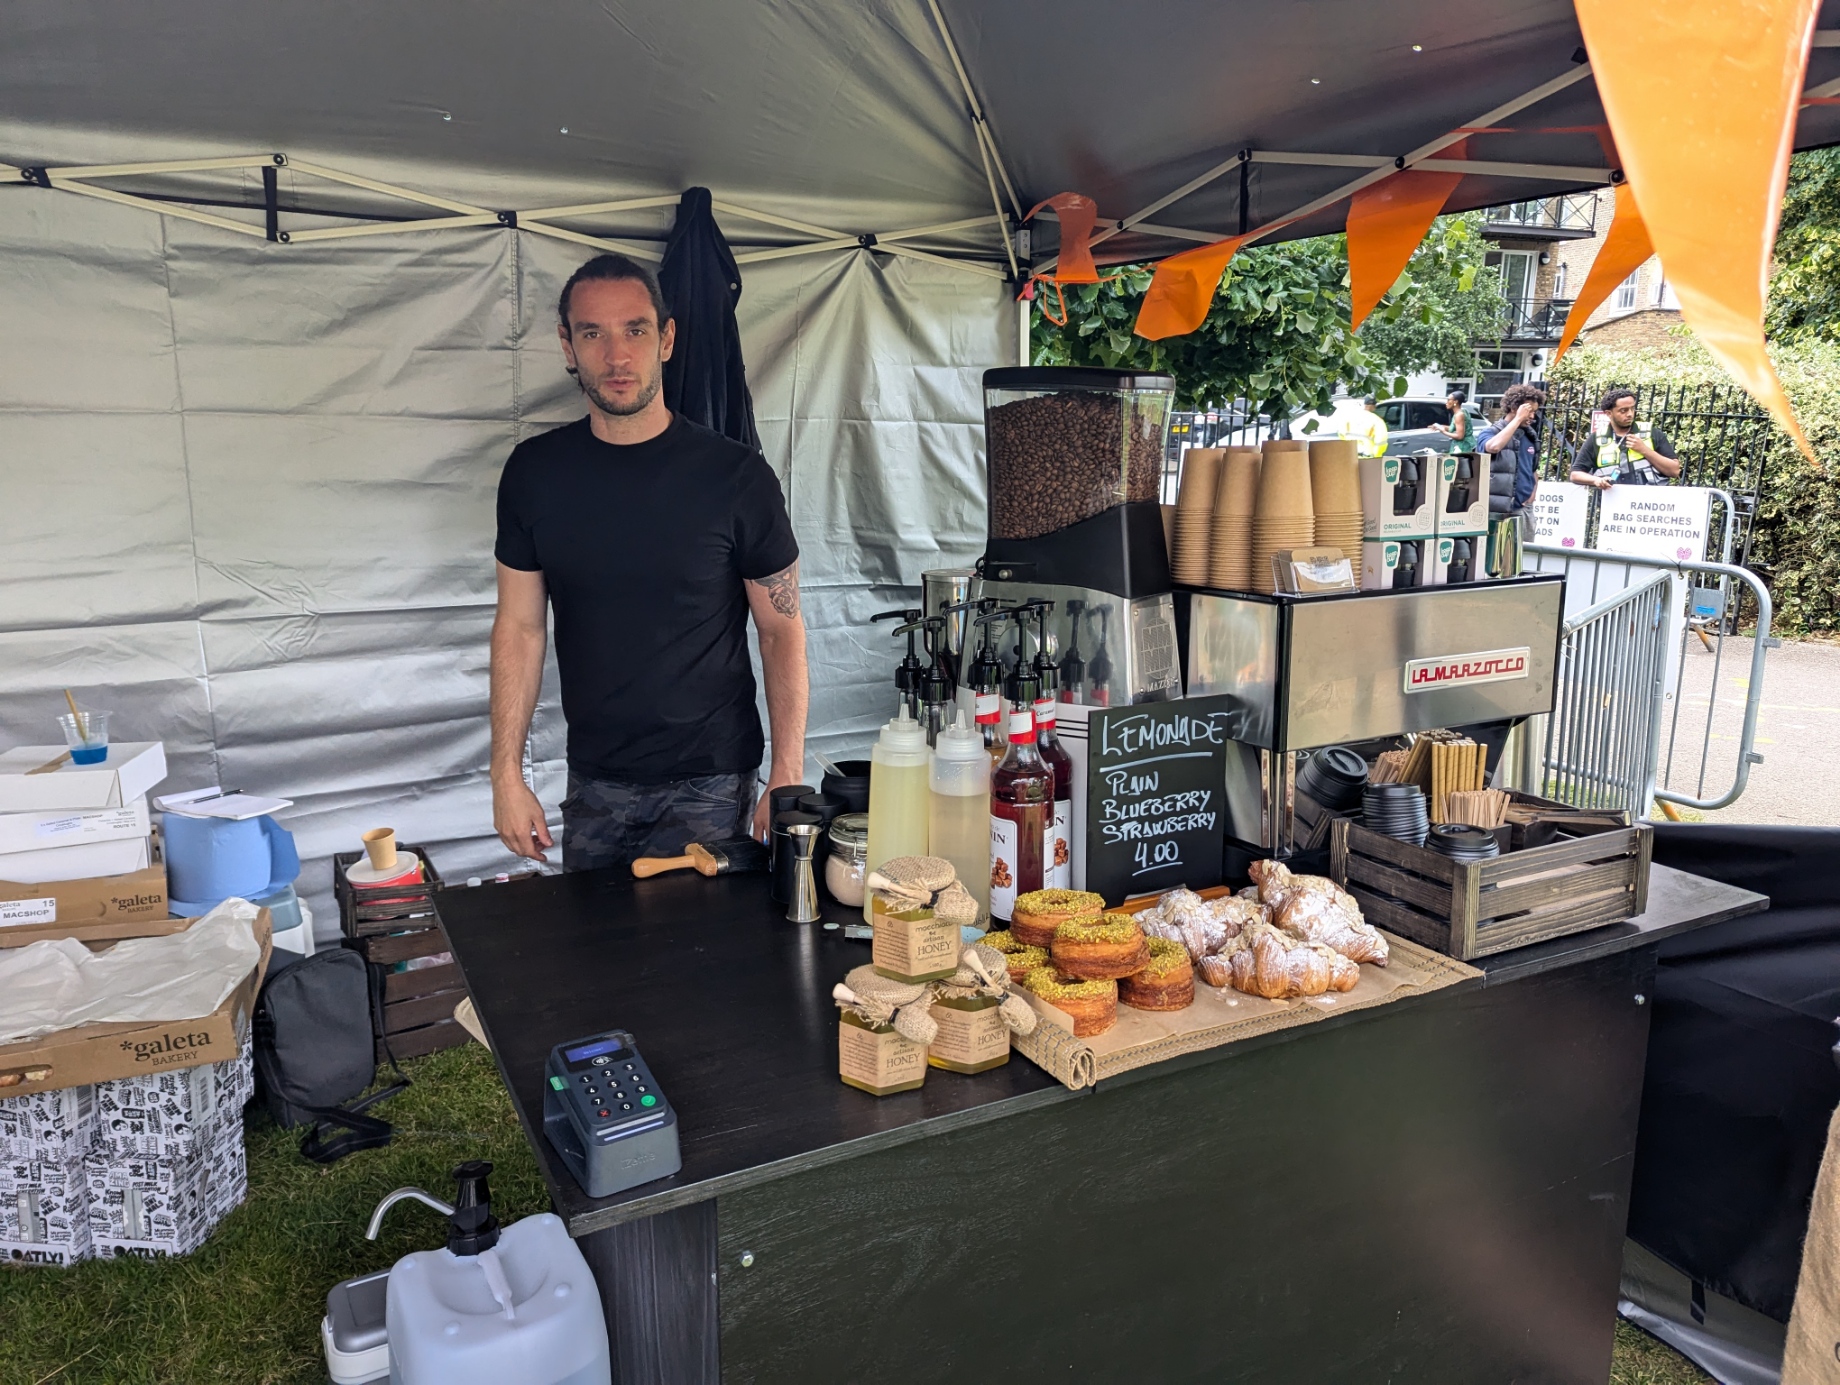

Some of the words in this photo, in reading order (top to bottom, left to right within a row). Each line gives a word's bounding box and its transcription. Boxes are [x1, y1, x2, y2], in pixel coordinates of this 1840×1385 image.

[1539, 494, 1564, 503] DOGS
[1534, 505, 1545, 513] ST
[1547, 506, 1560, 514] BE
[1630, 502, 1675, 512] RANDOM
[1383, 522, 1412, 530] ORIGINAL
[1546, 517, 1560, 526] ON
[1613, 512, 1633, 522] BAG
[1636, 514, 1692, 526] SEARCHES
[1535, 527, 1553, 537] ADS
[1603, 524, 1623, 533] ARE
[1626, 525, 1636, 534] IN
[1639, 526, 1700, 539] OPERATION
[1412, 668, 1429, 684] LA
[1434, 657, 1525, 682] MARZOCCO
[1102, 713, 1231, 756] LEMONADE
[1105, 770, 1159, 797] PLAIN
[1098, 790, 1211, 824] BLUEBERRY
[1102, 812, 1216, 845] STRAWBERRY
[1134, 840, 1180, 869] 4.00
[3, 909, 50, 919] MACSHOP
[127, 905, 155, 914] BAKERY
[917, 940, 952, 956] HONEY
[977, 1028, 1007, 1045] HONEY
[152, 1050, 199, 1066] BAKERY
[886, 1053, 921, 1068] HONEY
[11, 1249, 64, 1264] OATLY!
